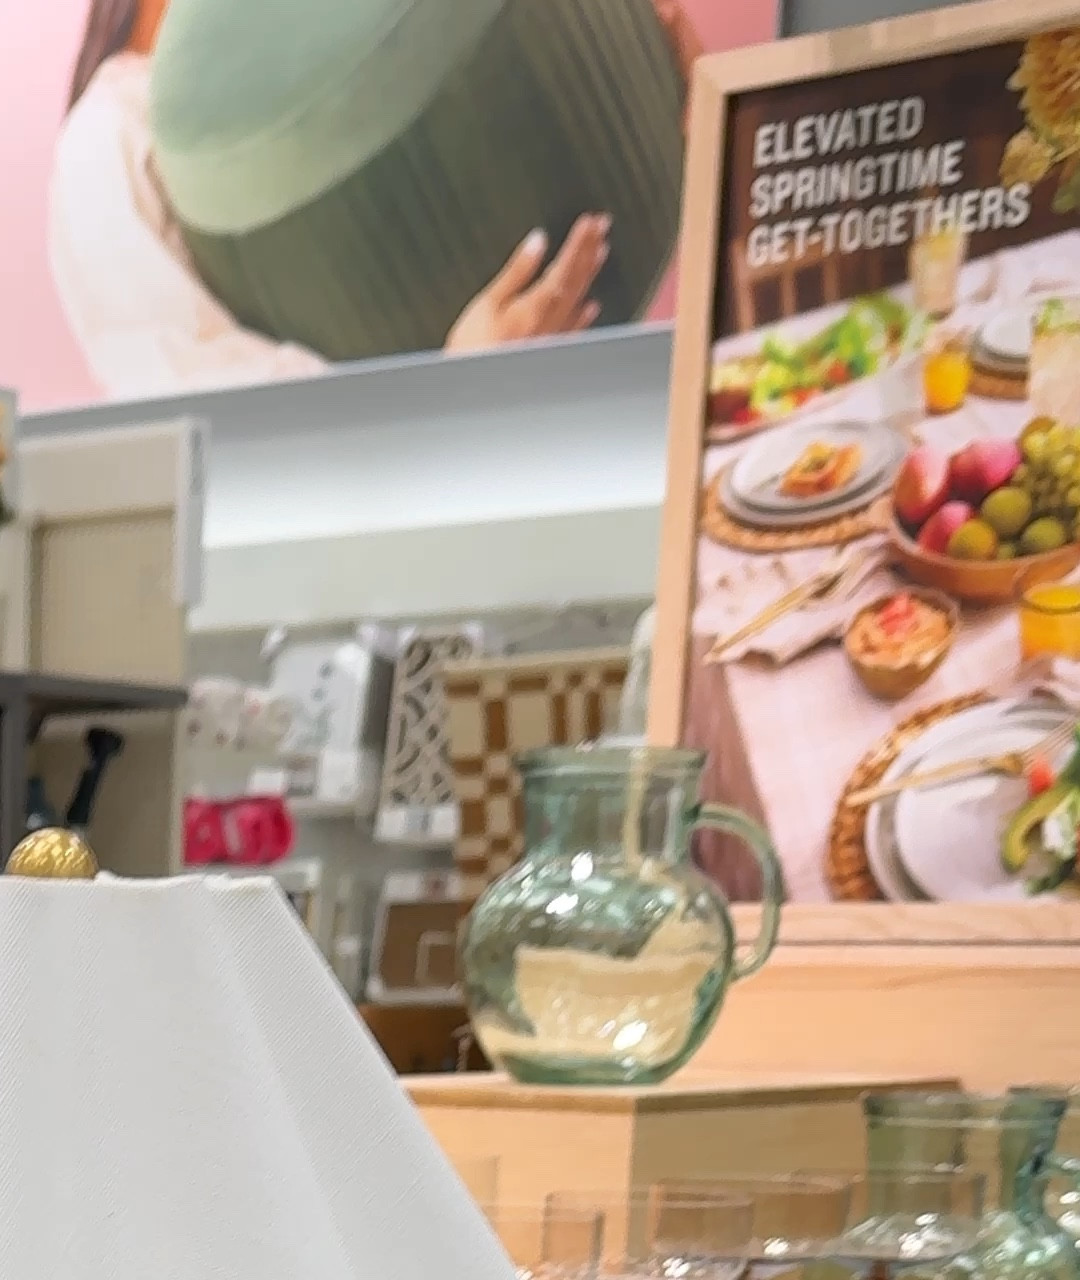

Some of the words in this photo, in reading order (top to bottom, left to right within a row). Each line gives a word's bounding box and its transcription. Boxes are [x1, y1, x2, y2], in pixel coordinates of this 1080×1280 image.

[752, 96, 925, 168] ELEVATED
[748, 140, 966, 218] SPRINGTIME
[746, 182, 1032, 268] GET-TOGETHERS
